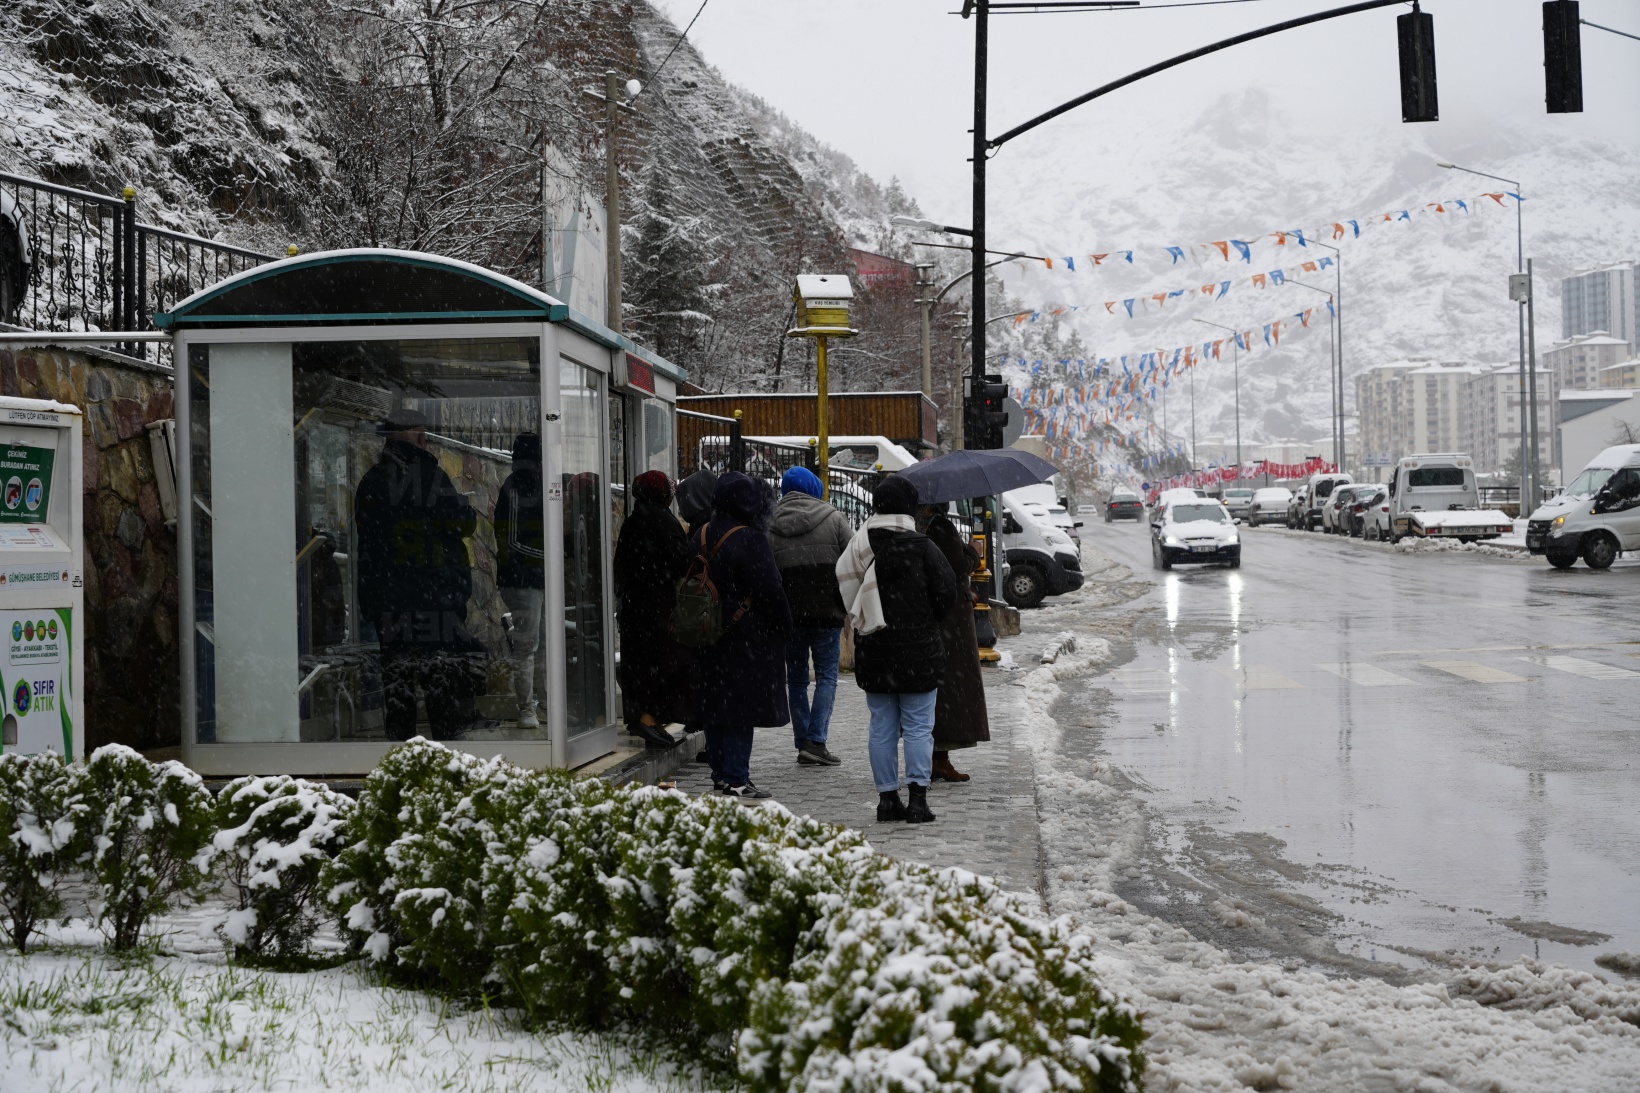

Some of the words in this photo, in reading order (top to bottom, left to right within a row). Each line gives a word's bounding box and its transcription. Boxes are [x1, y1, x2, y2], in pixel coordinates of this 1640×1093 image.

[9, 411, 26, 420] LÜTFEN
[27, 413, 36, 421] ÇÖP
[37, 413, 59, 422] ATMAYINIZ
[7, 450, 27, 459] ÇEKİNİZ
[0, 461, 24, 470] BURADAN
[24, 463, 40, 471] ATINIZ
[9, 571, 35, 583] GÜMÜŞHANE
[36, 570, 59, 581] BELEDİYESİ
[33, 680, 54, 695] SIFIR
[33, 696, 54, 712] ATIK
